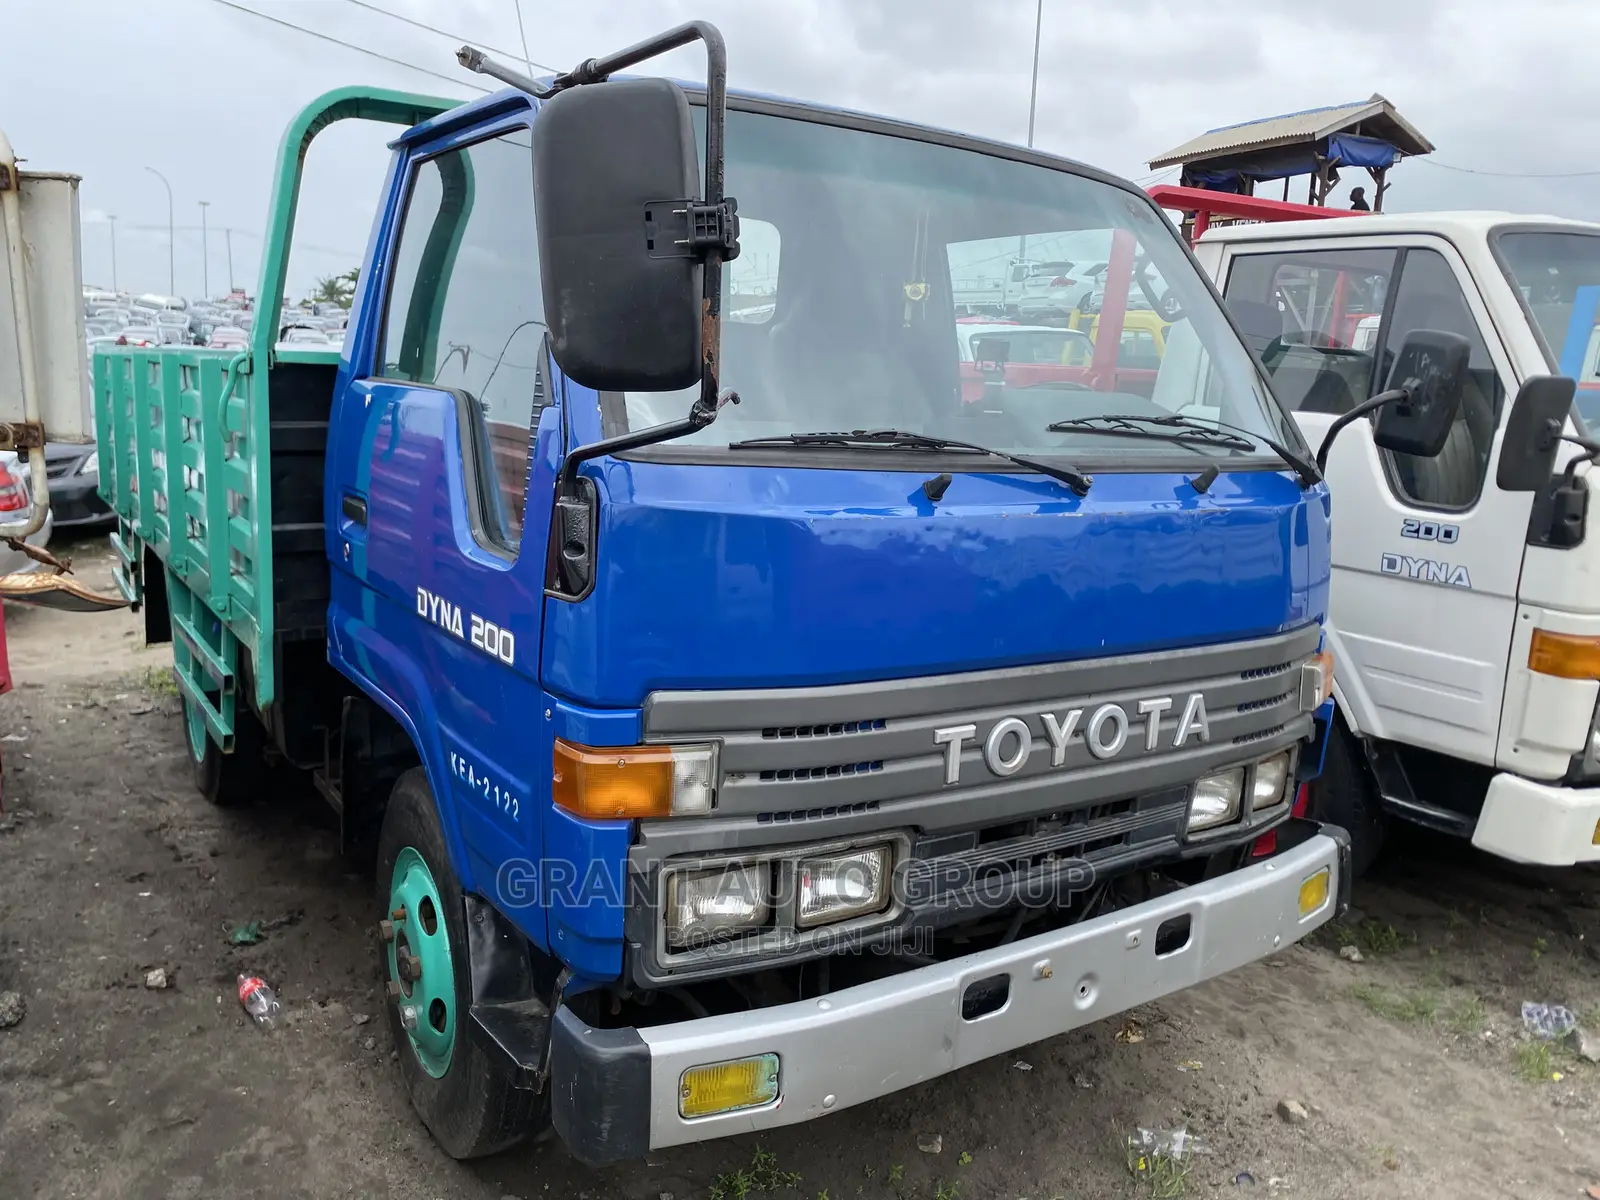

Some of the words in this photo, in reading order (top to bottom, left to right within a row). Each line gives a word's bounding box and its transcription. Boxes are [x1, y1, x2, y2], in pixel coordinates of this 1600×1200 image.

[1401, 518, 1460, 544] 200
[1381, 552, 1472, 588] DYNA
[416, 585, 465, 639] DYNA
[470, 612, 515, 666] 200
[933, 693, 1211, 785] TOYOTA
[450, 751, 520, 822] KEA-2122
